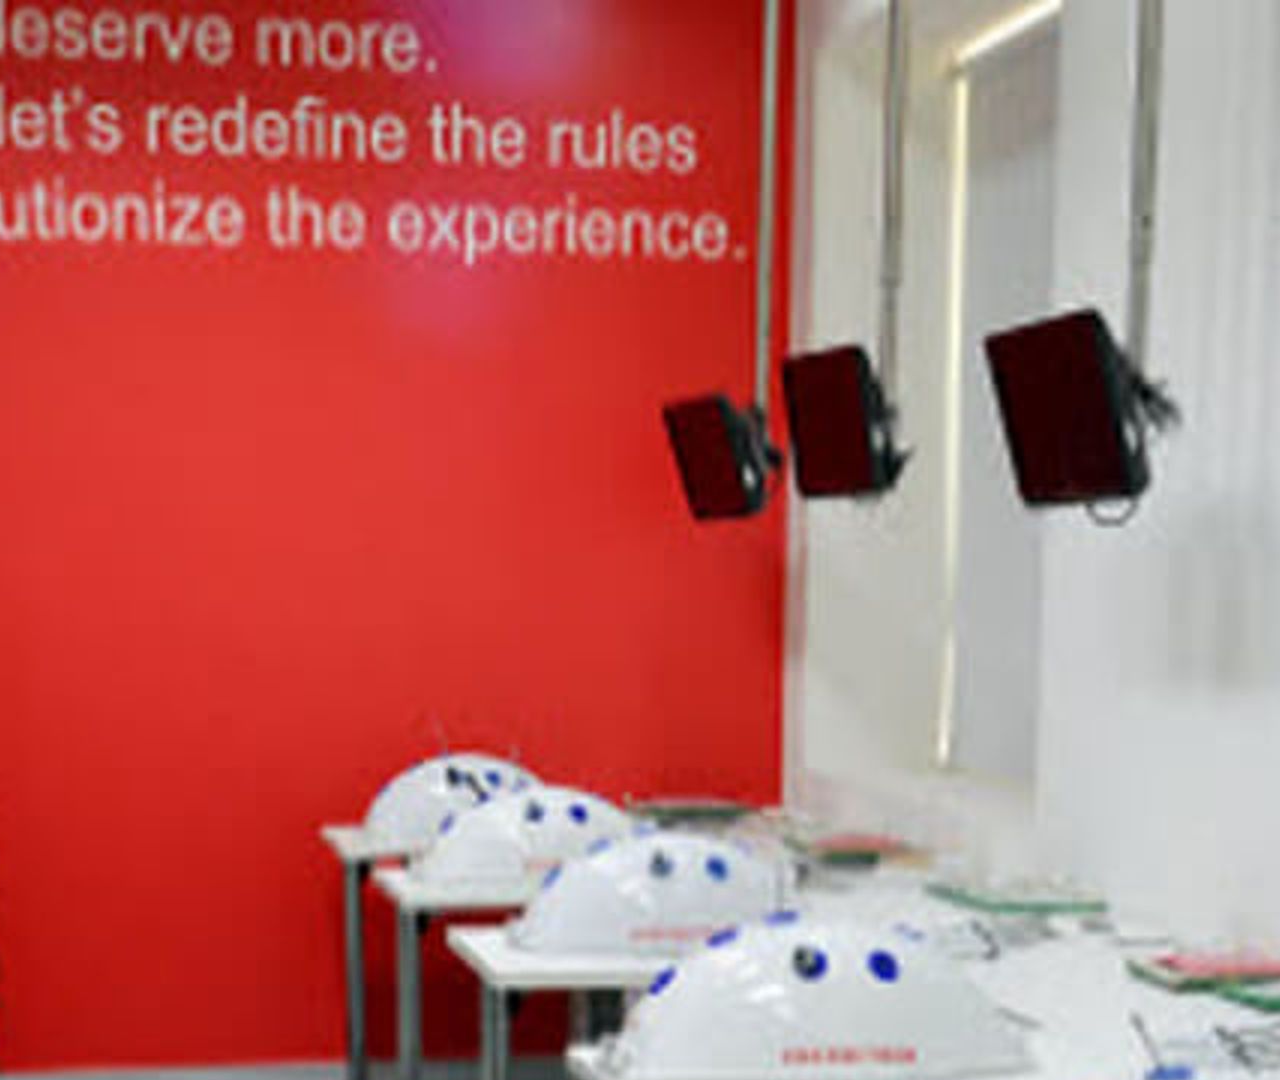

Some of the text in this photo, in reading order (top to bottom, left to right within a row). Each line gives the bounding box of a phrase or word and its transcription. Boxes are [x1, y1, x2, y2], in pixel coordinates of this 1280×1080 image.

[255, 17, 438, 74] more.
[146, 92, 409, 163] redefine
[428, 101, 527, 169] the
[547, 107, 699, 175] rules
[267, 184, 366, 251] the
[387, 193, 747, 268] experience.
